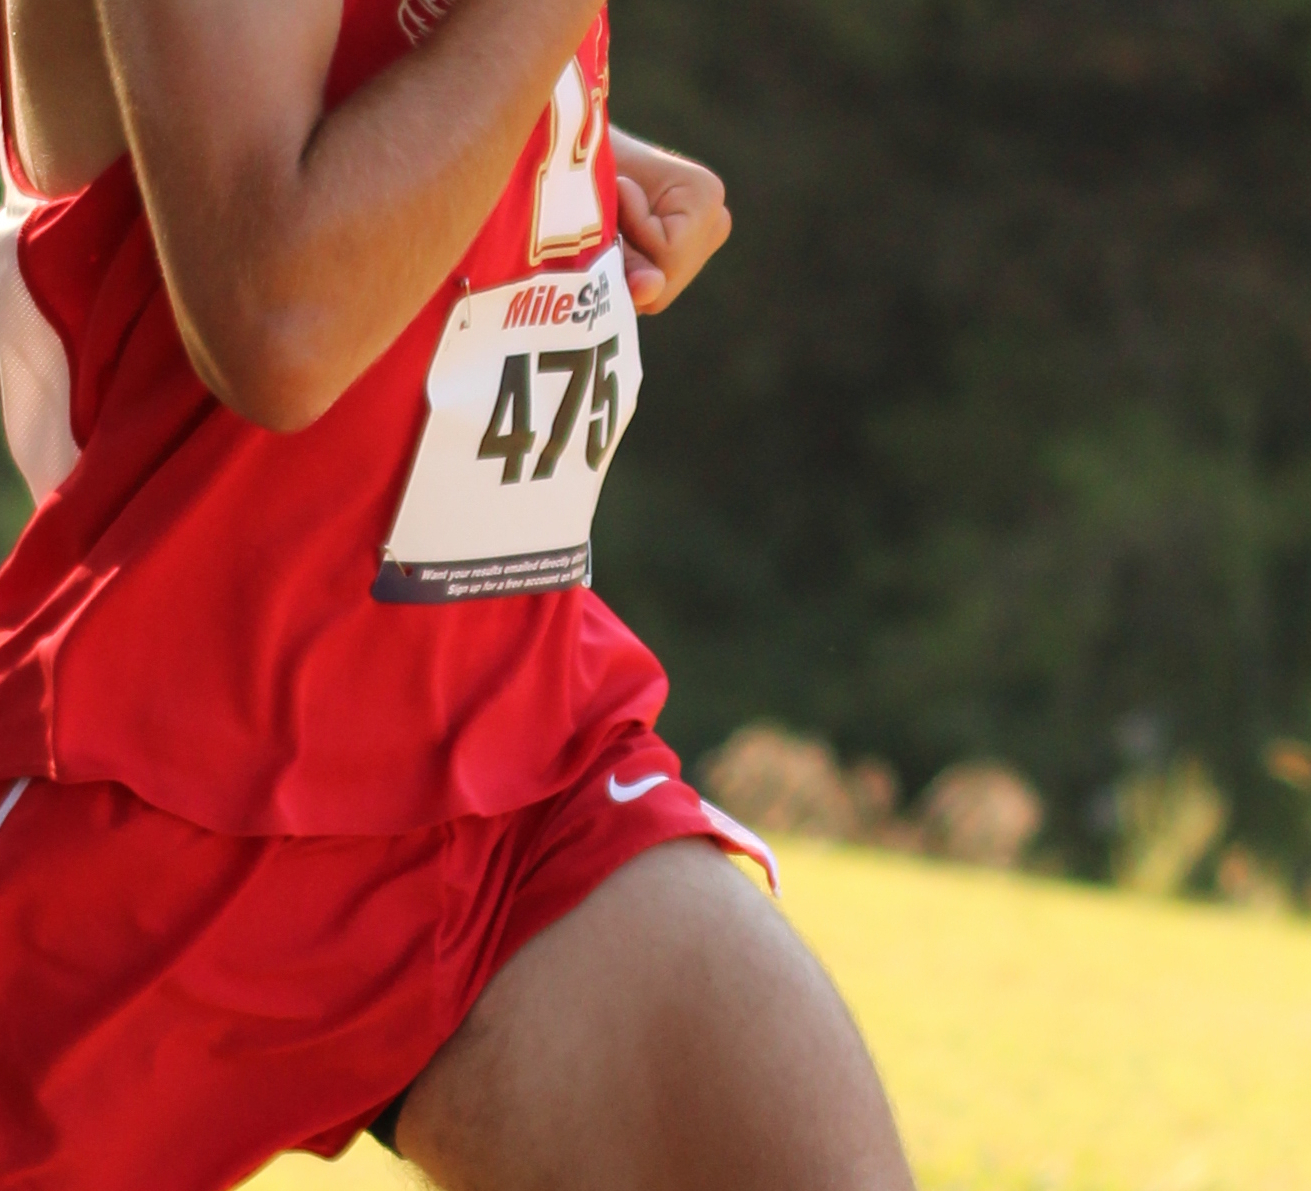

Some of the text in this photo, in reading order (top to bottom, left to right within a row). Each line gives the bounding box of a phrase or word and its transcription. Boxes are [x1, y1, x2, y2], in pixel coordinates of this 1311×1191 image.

[476, 333, 620, 486] 475
[421, 569, 449, 582] Want
[447, 570, 472, 582] your
[470, 565, 503, 578] results
[503, 560, 540, 575] emailed
[539, 555, 572, 570] directly
[447, 583, 469, 596] Sign
[468, 584, 482, 596] up
[481, 580, 498, 592] for
[504, 577, 524, 589] free
[523, 573, 561, 588] account
